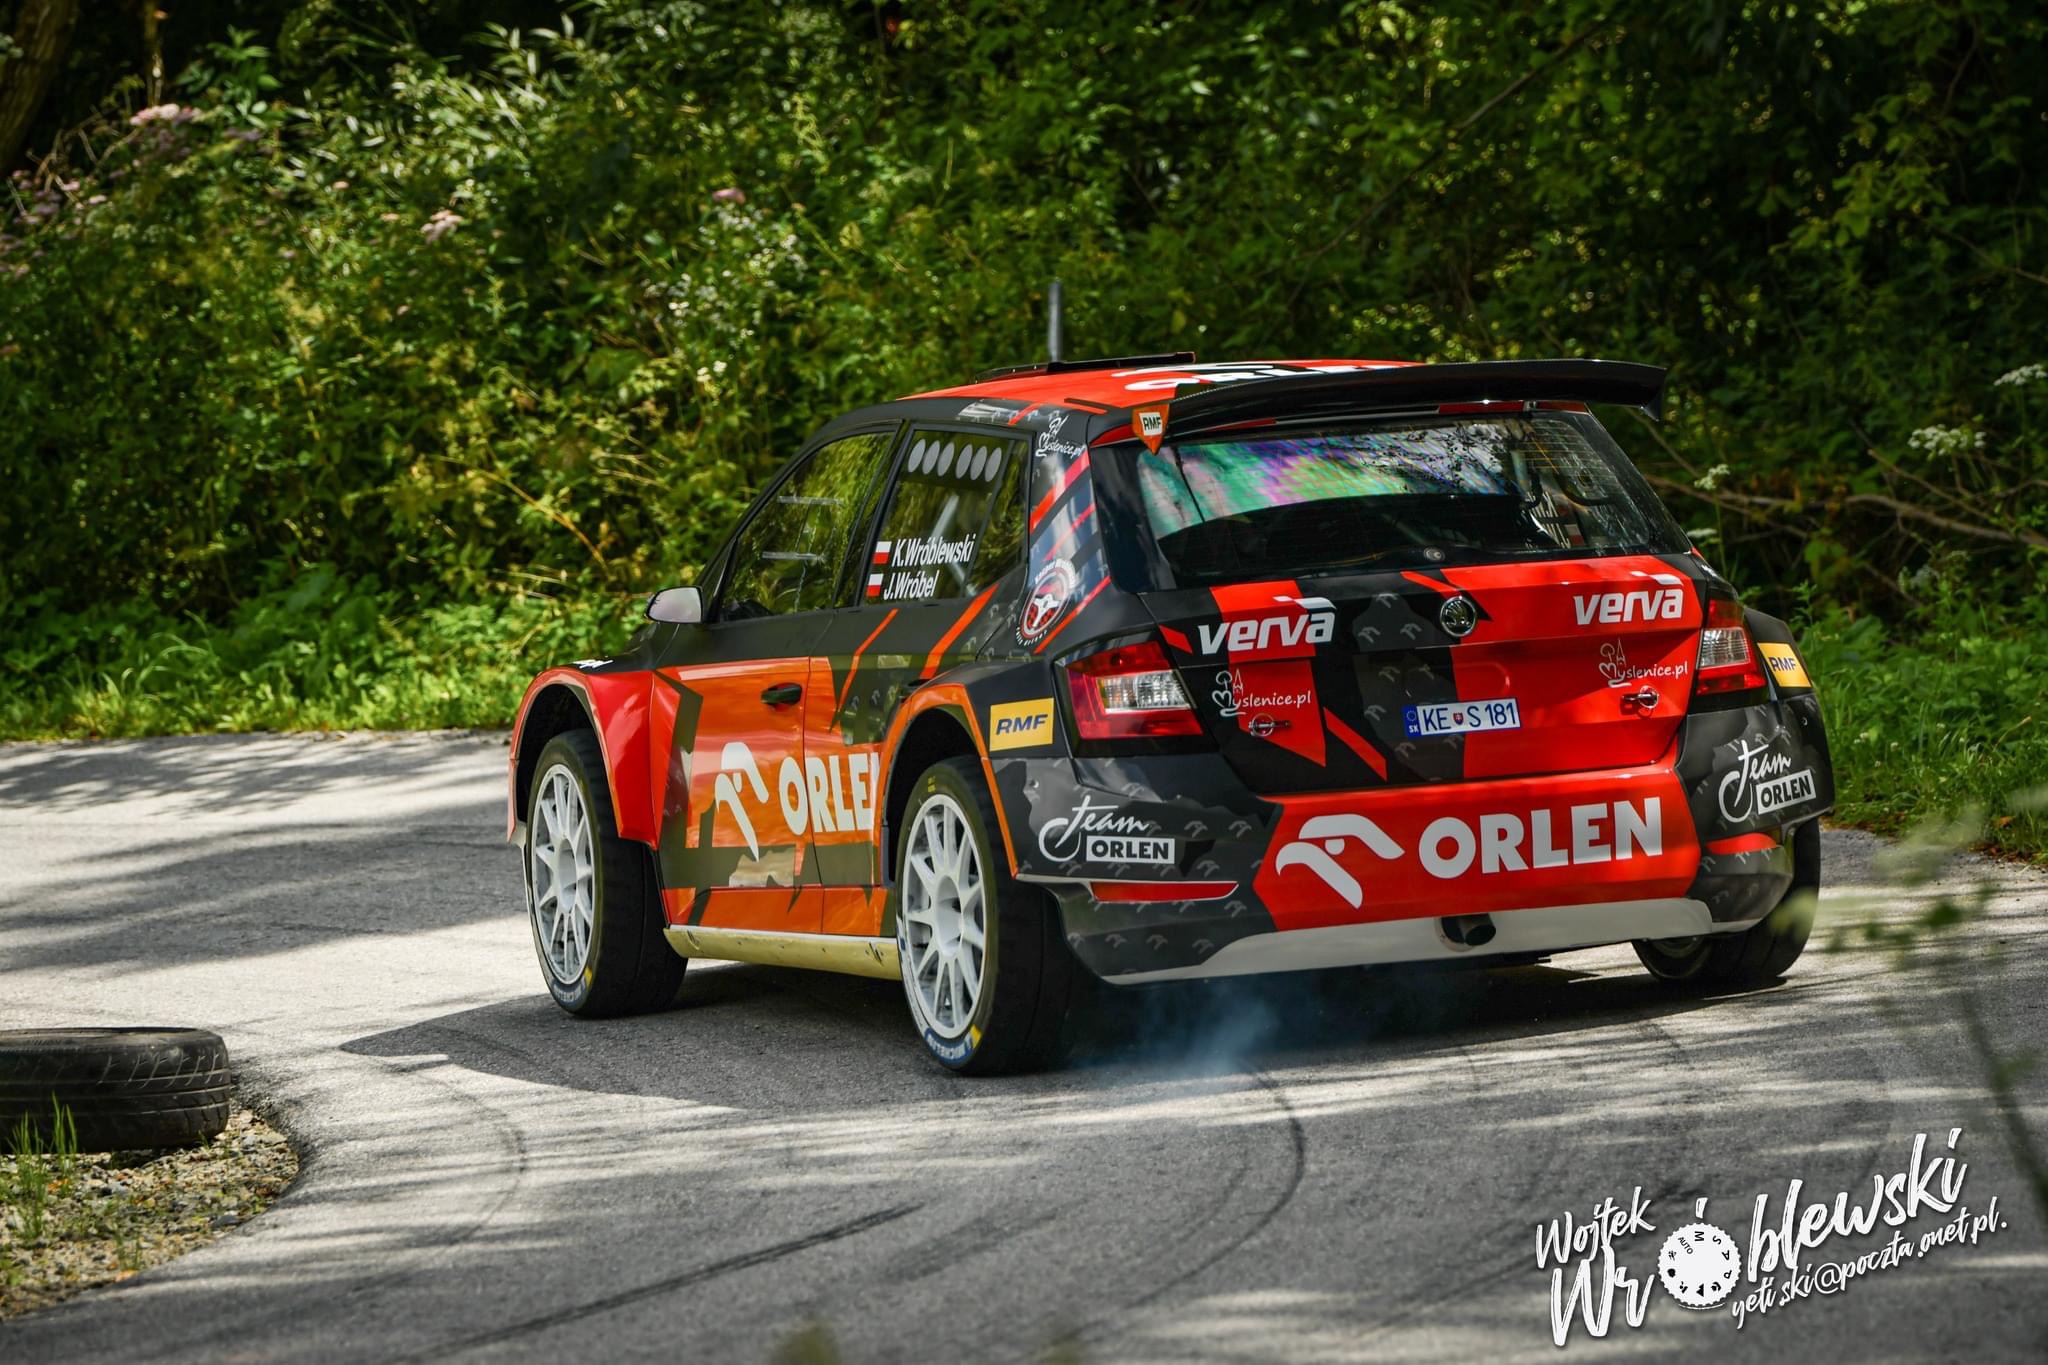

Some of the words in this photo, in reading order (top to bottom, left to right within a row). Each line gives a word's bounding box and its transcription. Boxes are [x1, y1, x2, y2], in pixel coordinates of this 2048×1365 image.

[1143, 416, 1162, 431] RMF
[891, 533, 977, 568] K.Wróblewski
[883, 570, 940, 600] J.Wróbel
[1573, 579, 1685, 626] verva
[1197, 602, 1337, 656] verva
[1768, 656, 1797, 673] RMF
[995, 714, 1049, 736] RMF
[1408, 724, 1419, 734] SK
[1422, 707, 1452, 732] KE
[1760, 775, 1813, 809] ORLEN
[1091, 839, 1169, 861] ORLEN
[1418, 796, 1663, 880] ORLEN
